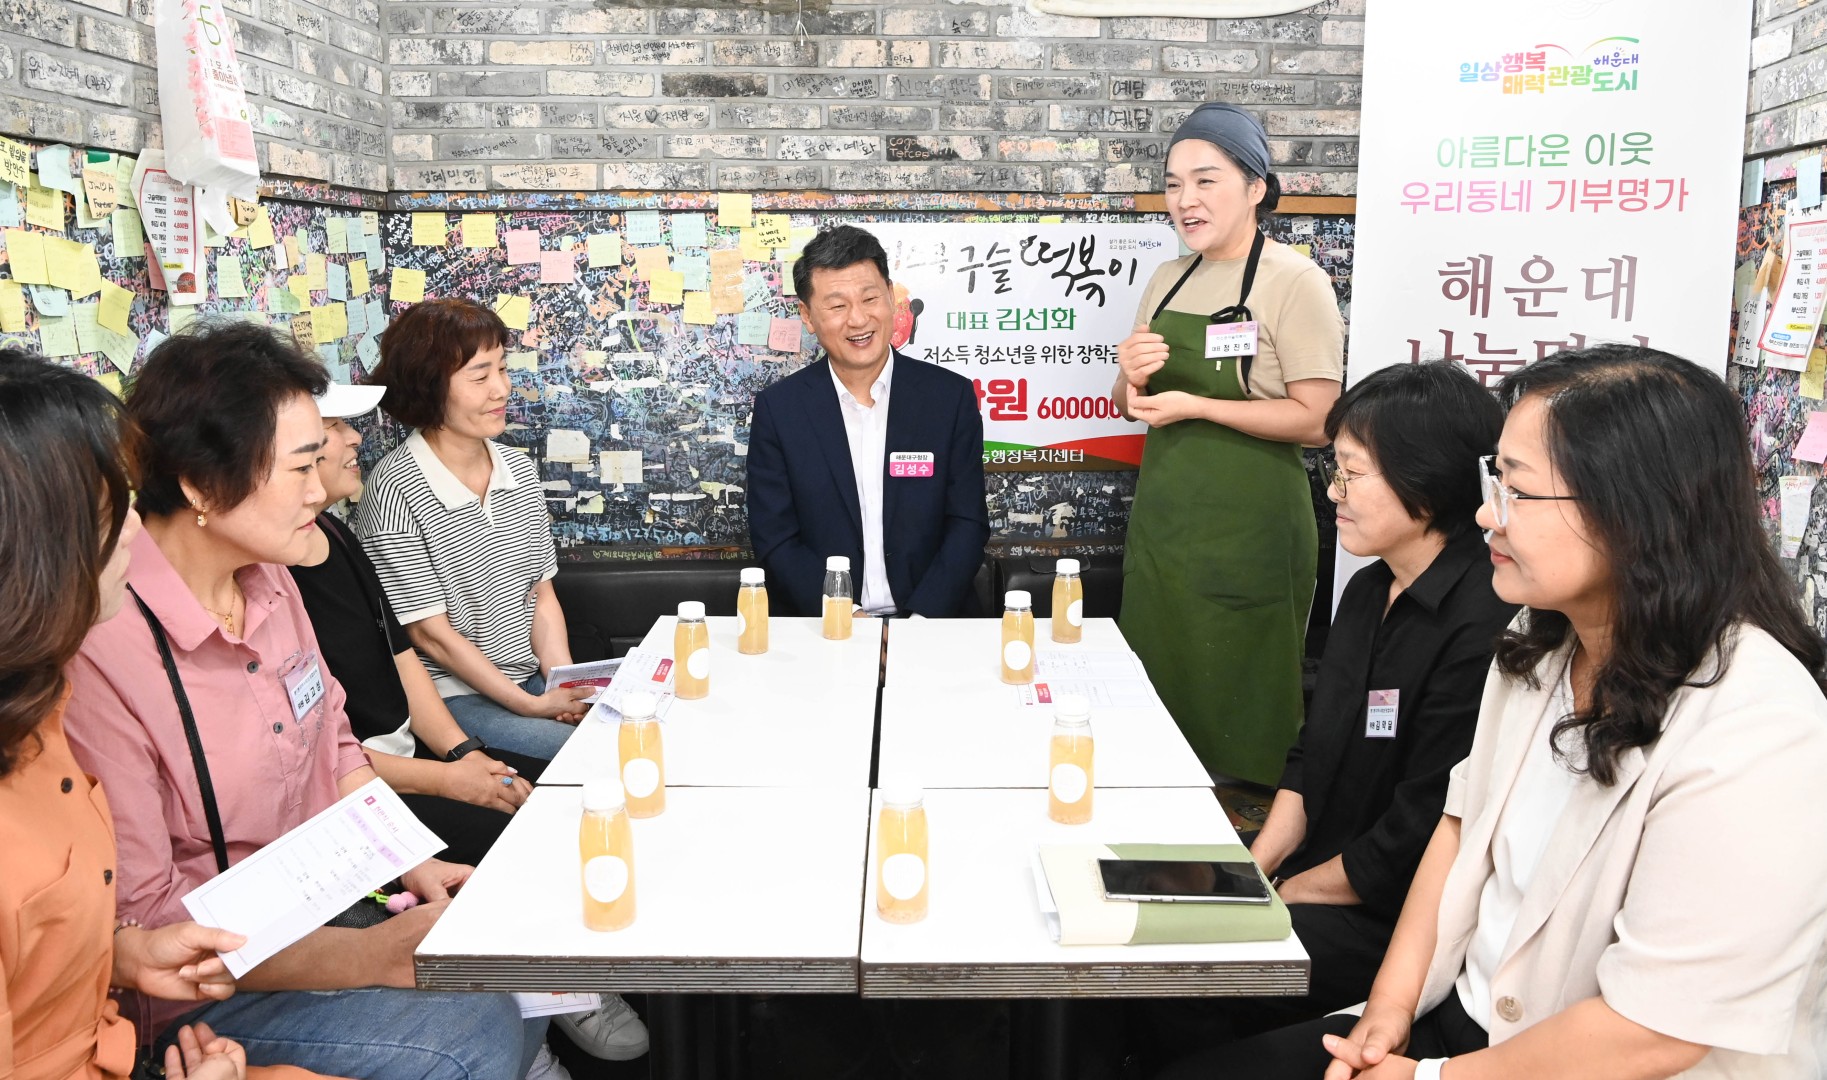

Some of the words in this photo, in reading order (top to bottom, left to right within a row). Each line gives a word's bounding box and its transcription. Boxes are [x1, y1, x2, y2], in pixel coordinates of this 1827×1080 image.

[1459, 62, 1501, 82] 일상
[1502, 51, 1546, 73] 행복
[1594, 53, 1639, 68] 해운대
[1112, 80, 1146, 99] 예담
[1503, 74, 1545, 94] 매력
[1547, 65, 1593, 87] 관광
[1592, 70, 1638, 92] 도시
[1437, 134, 1571, 169] 아름다운
[1585, 132, 1654, 167] 이웃
[1401, 182, 1532, 214] 우리동네
[1546, 178, 1688, 213] 기부명가
[1438, 254, 1637, 322] 해운대
[946, 311, 989, 331] 대표
[996, 307, 1077, 331] 김선화
[923, 345, 971, 366] 저소득
[974, 344, 1038, 366] 청소년을
[1040, 345, 1074, 365] 위한
[894, 464, 930, 475] 김성수
